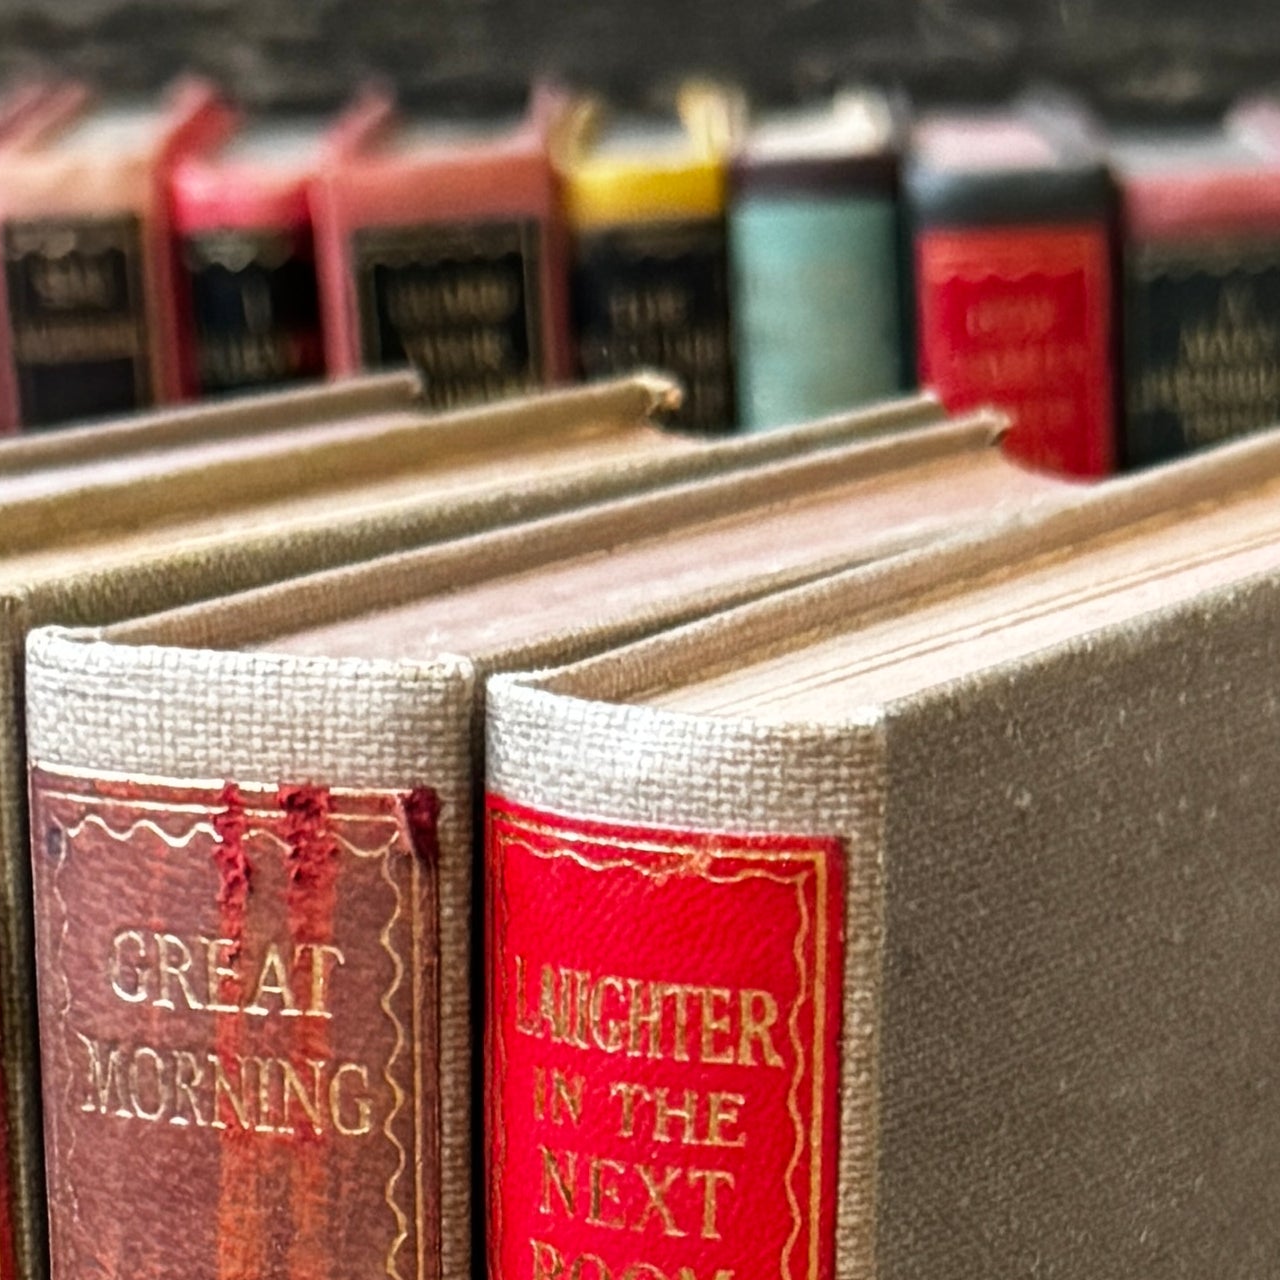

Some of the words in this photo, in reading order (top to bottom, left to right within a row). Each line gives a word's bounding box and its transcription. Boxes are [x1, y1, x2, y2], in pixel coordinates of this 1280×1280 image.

[110, 929, 345, 1019] GREAT
[514, 955, 786, 1069] LAUGHTER
[75, 1029, 374, 1136] MORNING
[533, 1066, 587, 1126] IN
[610, 1081, 747, 1148] THE
[537, 1144, 736, 1240] NEXT
